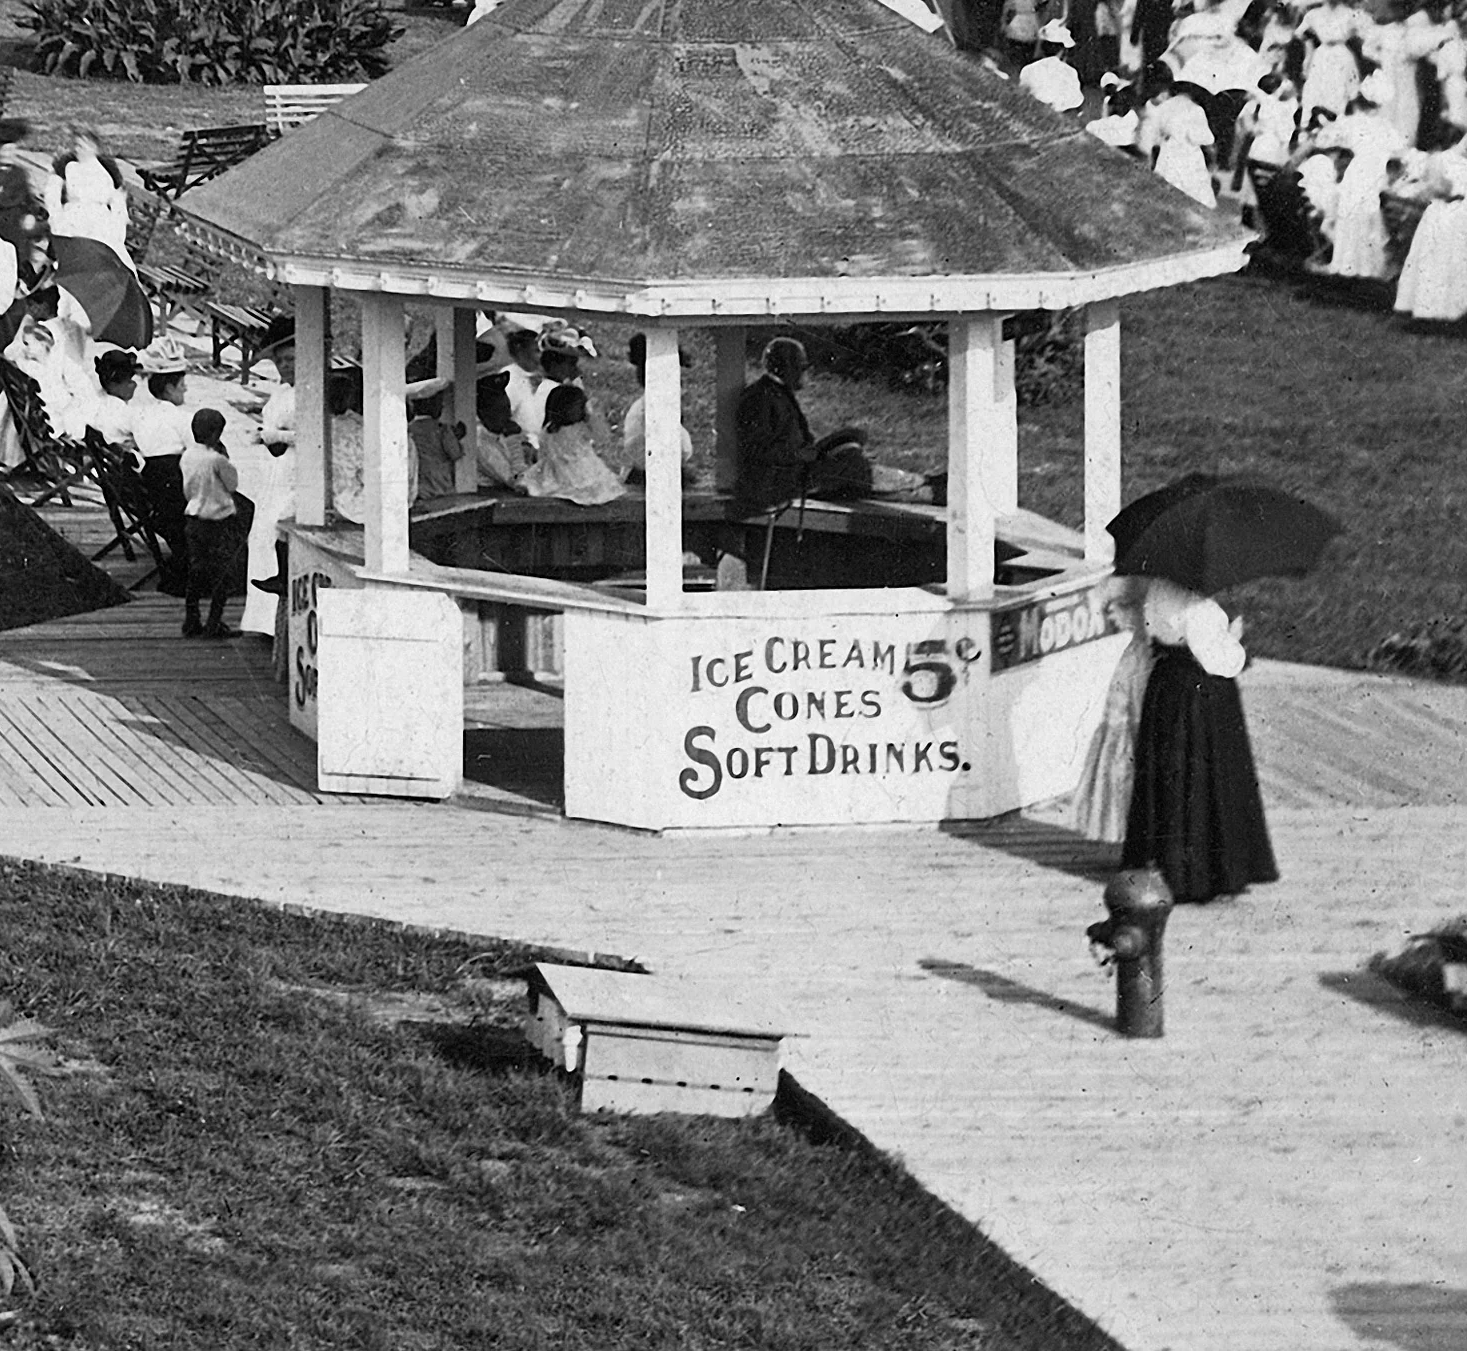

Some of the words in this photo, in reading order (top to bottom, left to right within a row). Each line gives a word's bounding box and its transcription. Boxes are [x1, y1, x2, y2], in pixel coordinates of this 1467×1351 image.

[690, 649, 754, 693] ICE
[764, 636, 896, 675] CREAM
[735, 685, 882, 734] CONES
[678, 725, 799, 800] SOFT
